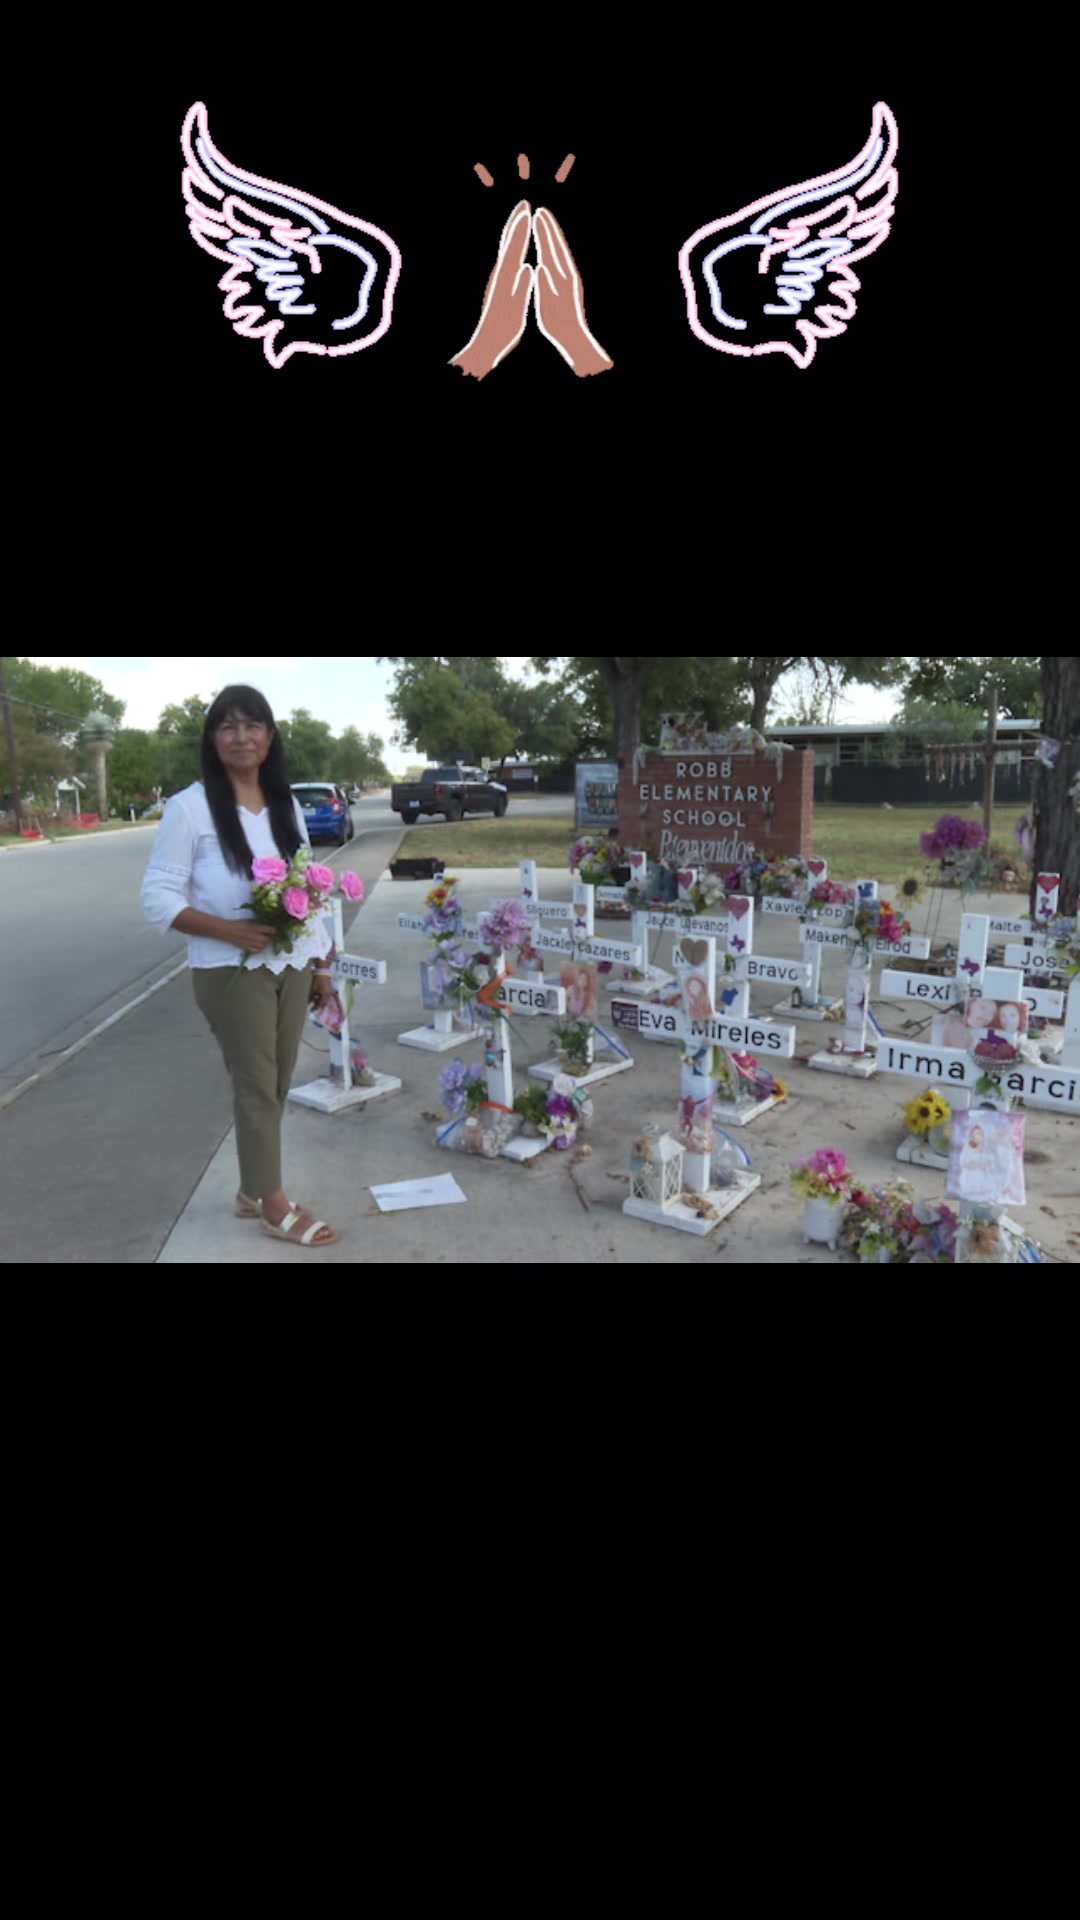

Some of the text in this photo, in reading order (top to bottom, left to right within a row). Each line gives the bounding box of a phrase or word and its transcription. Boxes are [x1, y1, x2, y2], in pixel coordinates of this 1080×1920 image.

[676, 762, 732, 778] ROBB
[640, 784, 772, 802] ELEMENTARY
[662, 809, 746, 827] SCHOOL
[334, 959, 377, 979] Torres
[498, 984, 546, 1008] arcia
[906, 979, 950, 1000] Lexi
[639, 1009, 676, 1032] Eva
[691, 1020, 782, 1050] Mireles
[887, 1048, 1080, 1100] Irma arci
